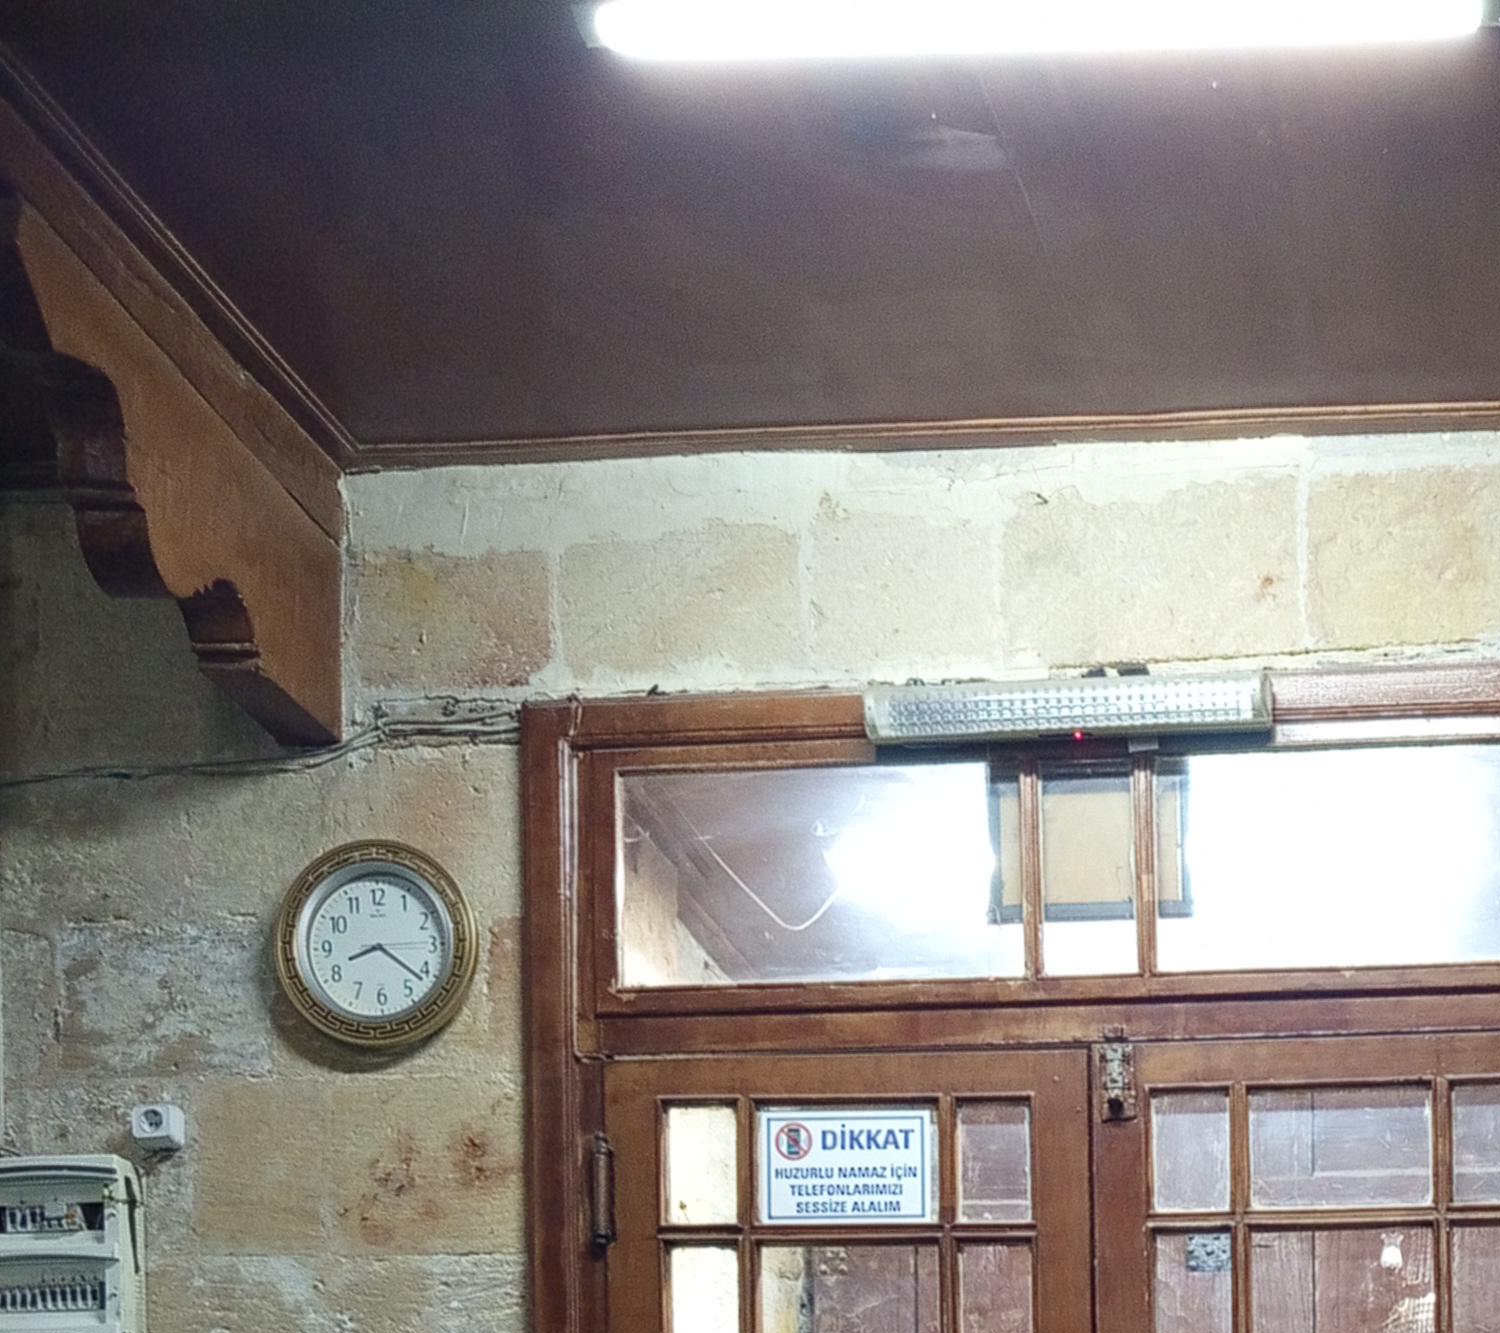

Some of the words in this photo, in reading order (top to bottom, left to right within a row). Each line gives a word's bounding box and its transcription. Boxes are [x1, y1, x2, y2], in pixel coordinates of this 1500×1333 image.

[347, 896, 360, 914] 11
[369, 888, 386, 907] 12
[401, 895, 408, 912] 1
[330, 915, 348, 934] 10
[419, 912, 430, 931] 2
[321, 939, 333, 958] 9
[428, 935, 438, 954] 3
[331, 964, 342, 983] 8
[419, 960, 430, 978] 4
[353, 981, 364, 1000] 7
[376, 987, 388, 1006] 6
[403, 979, 414, 998] 5
[820, 1123, 915, 1151] DİKKAT
[774, 1167, 834, 1180] HUZURLU
[837, 1166, 887, 1179] NAMAZ
[890, 1163, 918, 1181] İÇİN
[789, 1183, 904, 1197] TELEFONLARIMIZI
[795, 1198, 848, 1214] SESSİZE
[851, 1200, 902, 1213] ALALIM
